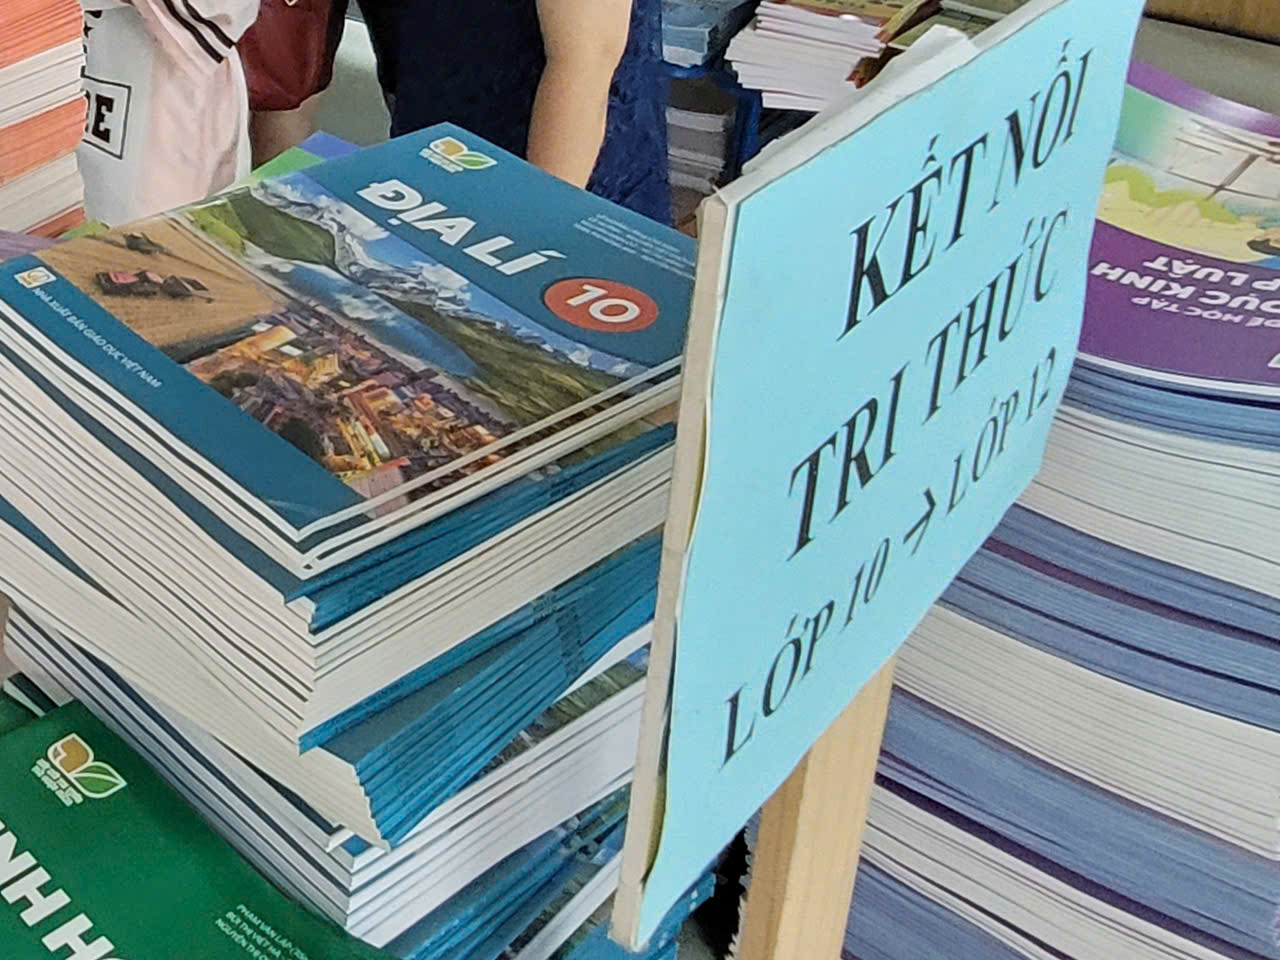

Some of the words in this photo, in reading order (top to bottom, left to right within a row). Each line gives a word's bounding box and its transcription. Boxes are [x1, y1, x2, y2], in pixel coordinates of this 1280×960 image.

[836, 133, 989, 342] KẾT
[987, 37, 1094, 213] NỐI
[356, 178, 478, 246] ĐỊA
[462, 235, 568, 276] LÍ
[1090, 261, 1197, 299] KINH
[1142, 255, 1250, 287] LUẬT
[566, 283, 641, 323] 10
[1131, 296, 1181, 313] TẬP
[1183, 305, 1245, 323] HỌC
[785, 360, 912, 562] TRI
[921, 202, 1070, 426] THỨC
[718, 614, 836, 773] LỚP
[842, 536, 891, 633] 10
[945, 388, 1020, 518] LỚP
[1025, 345, 1057, 424] 12
